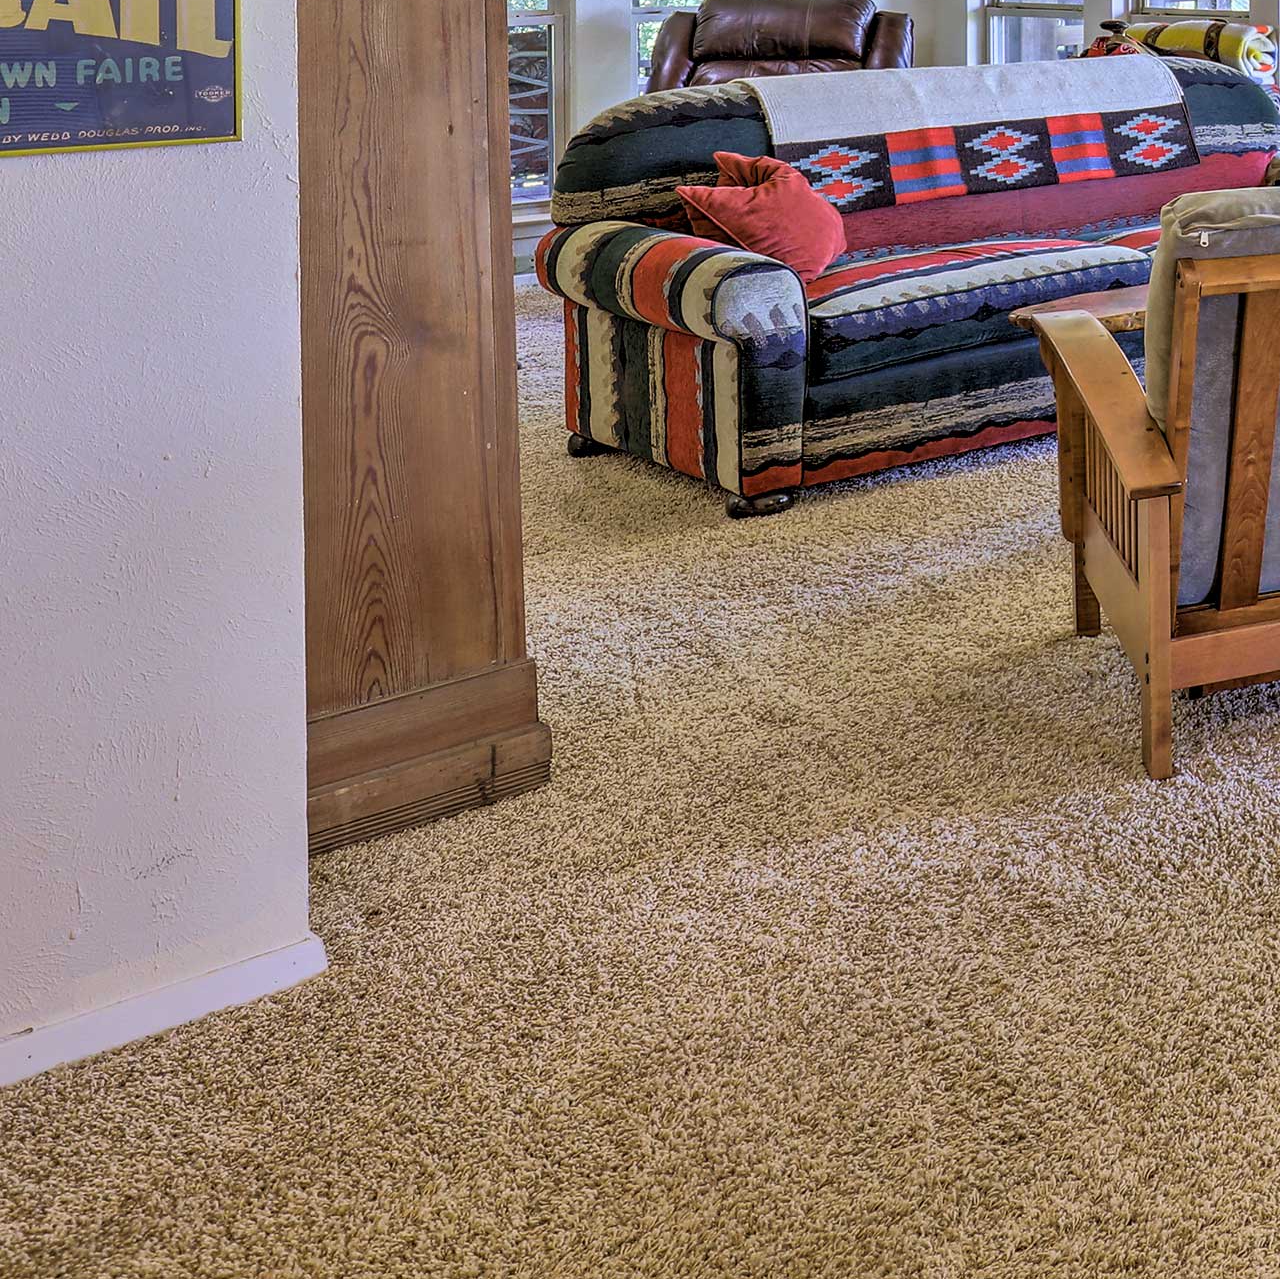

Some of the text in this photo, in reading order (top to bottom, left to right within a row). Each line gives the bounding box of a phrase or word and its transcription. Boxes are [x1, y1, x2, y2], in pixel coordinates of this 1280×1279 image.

[0, 56, 184, 89] WN FAIRE
[2, 135, 22, 144] BY
